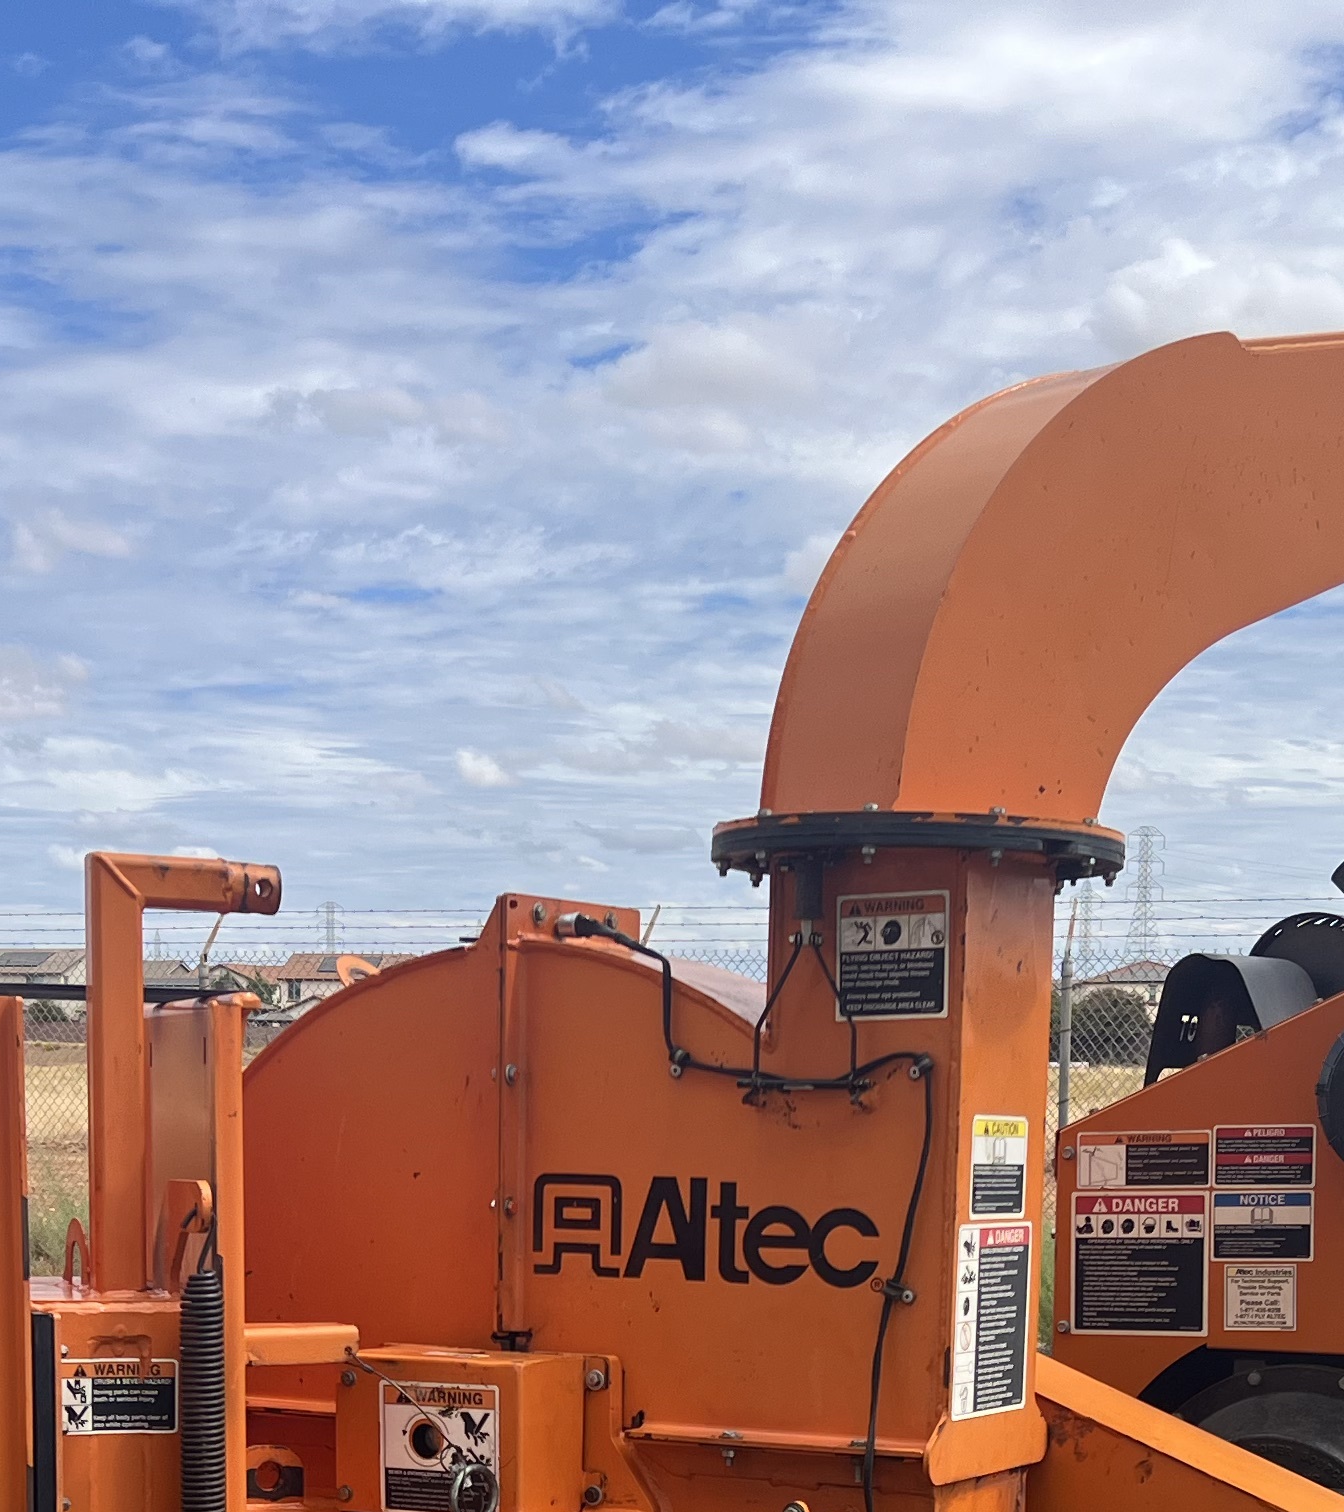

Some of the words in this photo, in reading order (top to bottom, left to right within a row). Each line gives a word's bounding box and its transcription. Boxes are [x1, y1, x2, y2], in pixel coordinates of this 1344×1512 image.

[864, 899, 924, 913] WARNING
[991, 1121, 1019, 1136] CAUTION
[1127, 1134, 1172, 1144] WARNING
[1112, 1198, 1179, 1213] DANGER
[1240, 1194, 1286, 1206] NOTICE
[622, 1176, 880, 1288] Altec
[994, 1229, 1025, 1245] DANGER
[94, 1363, 160, 1375] WARNIG
[416, 1389, 483, 1405] WARNING
